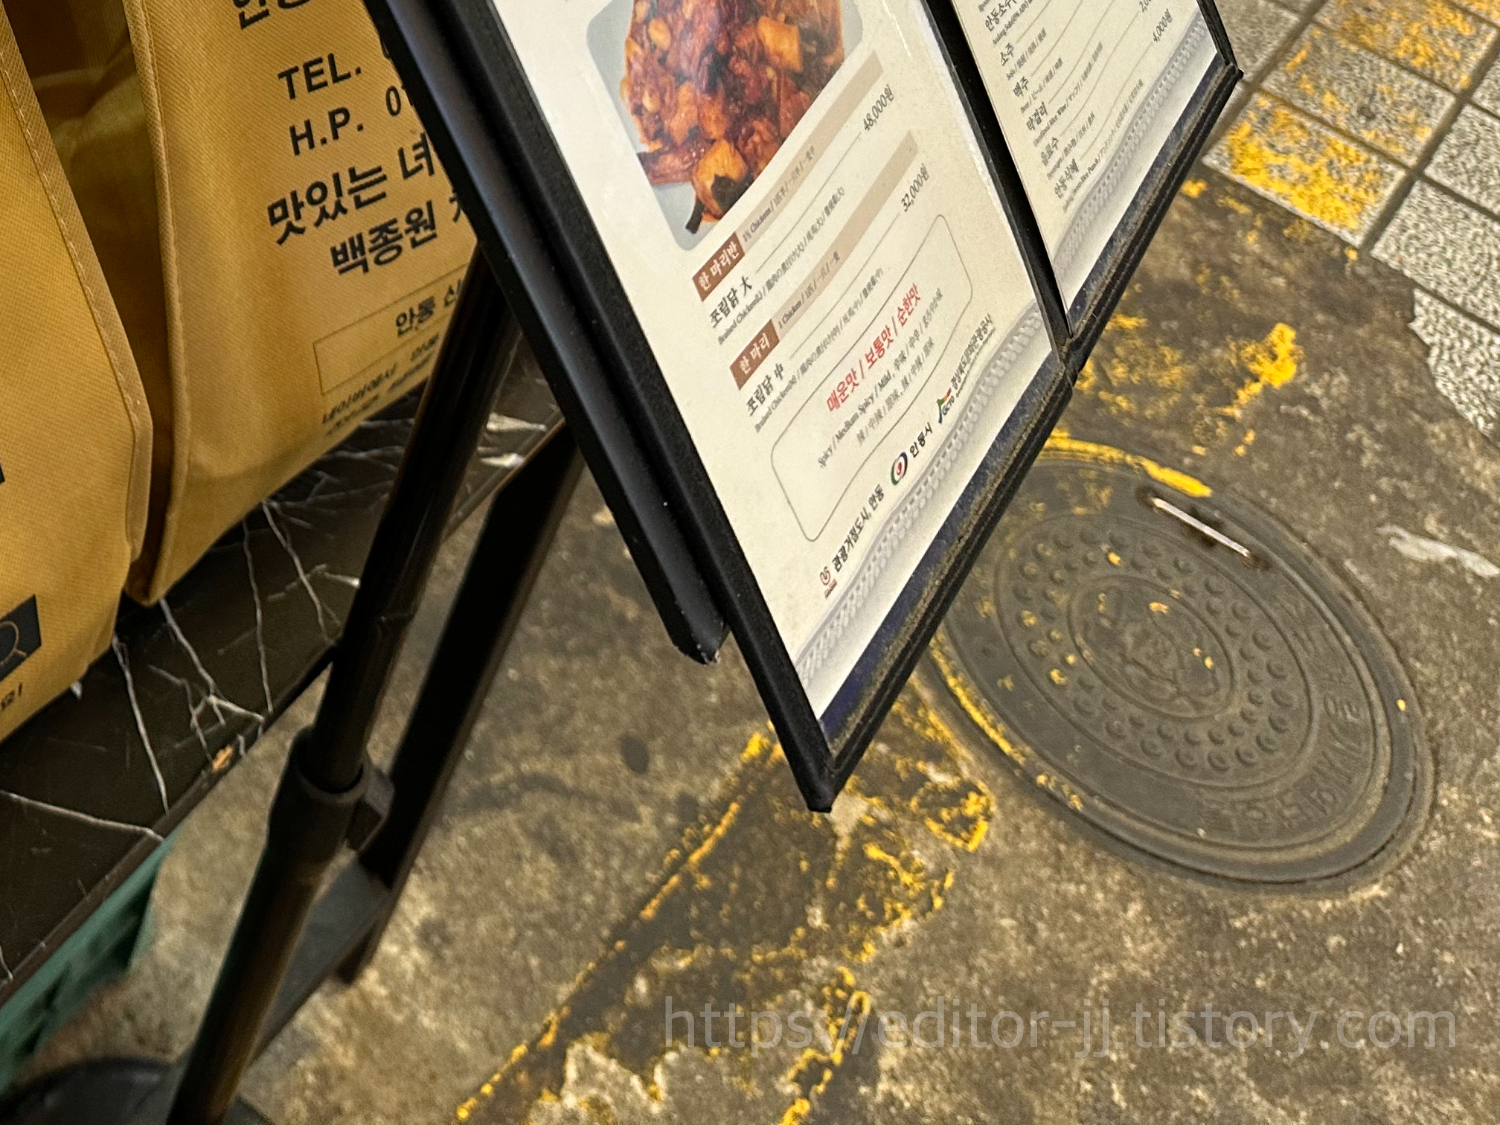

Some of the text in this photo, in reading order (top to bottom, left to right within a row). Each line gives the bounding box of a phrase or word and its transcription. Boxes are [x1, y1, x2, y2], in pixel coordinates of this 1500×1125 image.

[1151, 7, 1173, 42] 4,000원
[277, 52, 361, 99] TEL.
[999, 41, 1014, 67] 소주
[1011, 75, 1029, 97] 맥주
[288, 106, 363, 156] H.P.
[1025, 100, 1048, 131] 막걸리
[1039, 136, 1059, 167] 음료수
[267, 166, 387, 244] 맛있는
[740, 275, 753, 296] 大
[862, 83, 894, 131] 48,000원
[900, 162, 929, 212] 32,000원
[330, 200, 436, 274] 백종원
[697, 270, 711, 291] 한
[709, 240, 739, 276] 마리반
[394, 295, 436, 337] 안동
[738, 354, 751, 375] 한
[749, 331, 770, 360] 마리
[825, 367, 859, 411] 매운맛
[864, 324, 894, 369] 보통맛
[896, 282, 921, 327] 순한맛
[908, 421, 933, 458] 안동시
